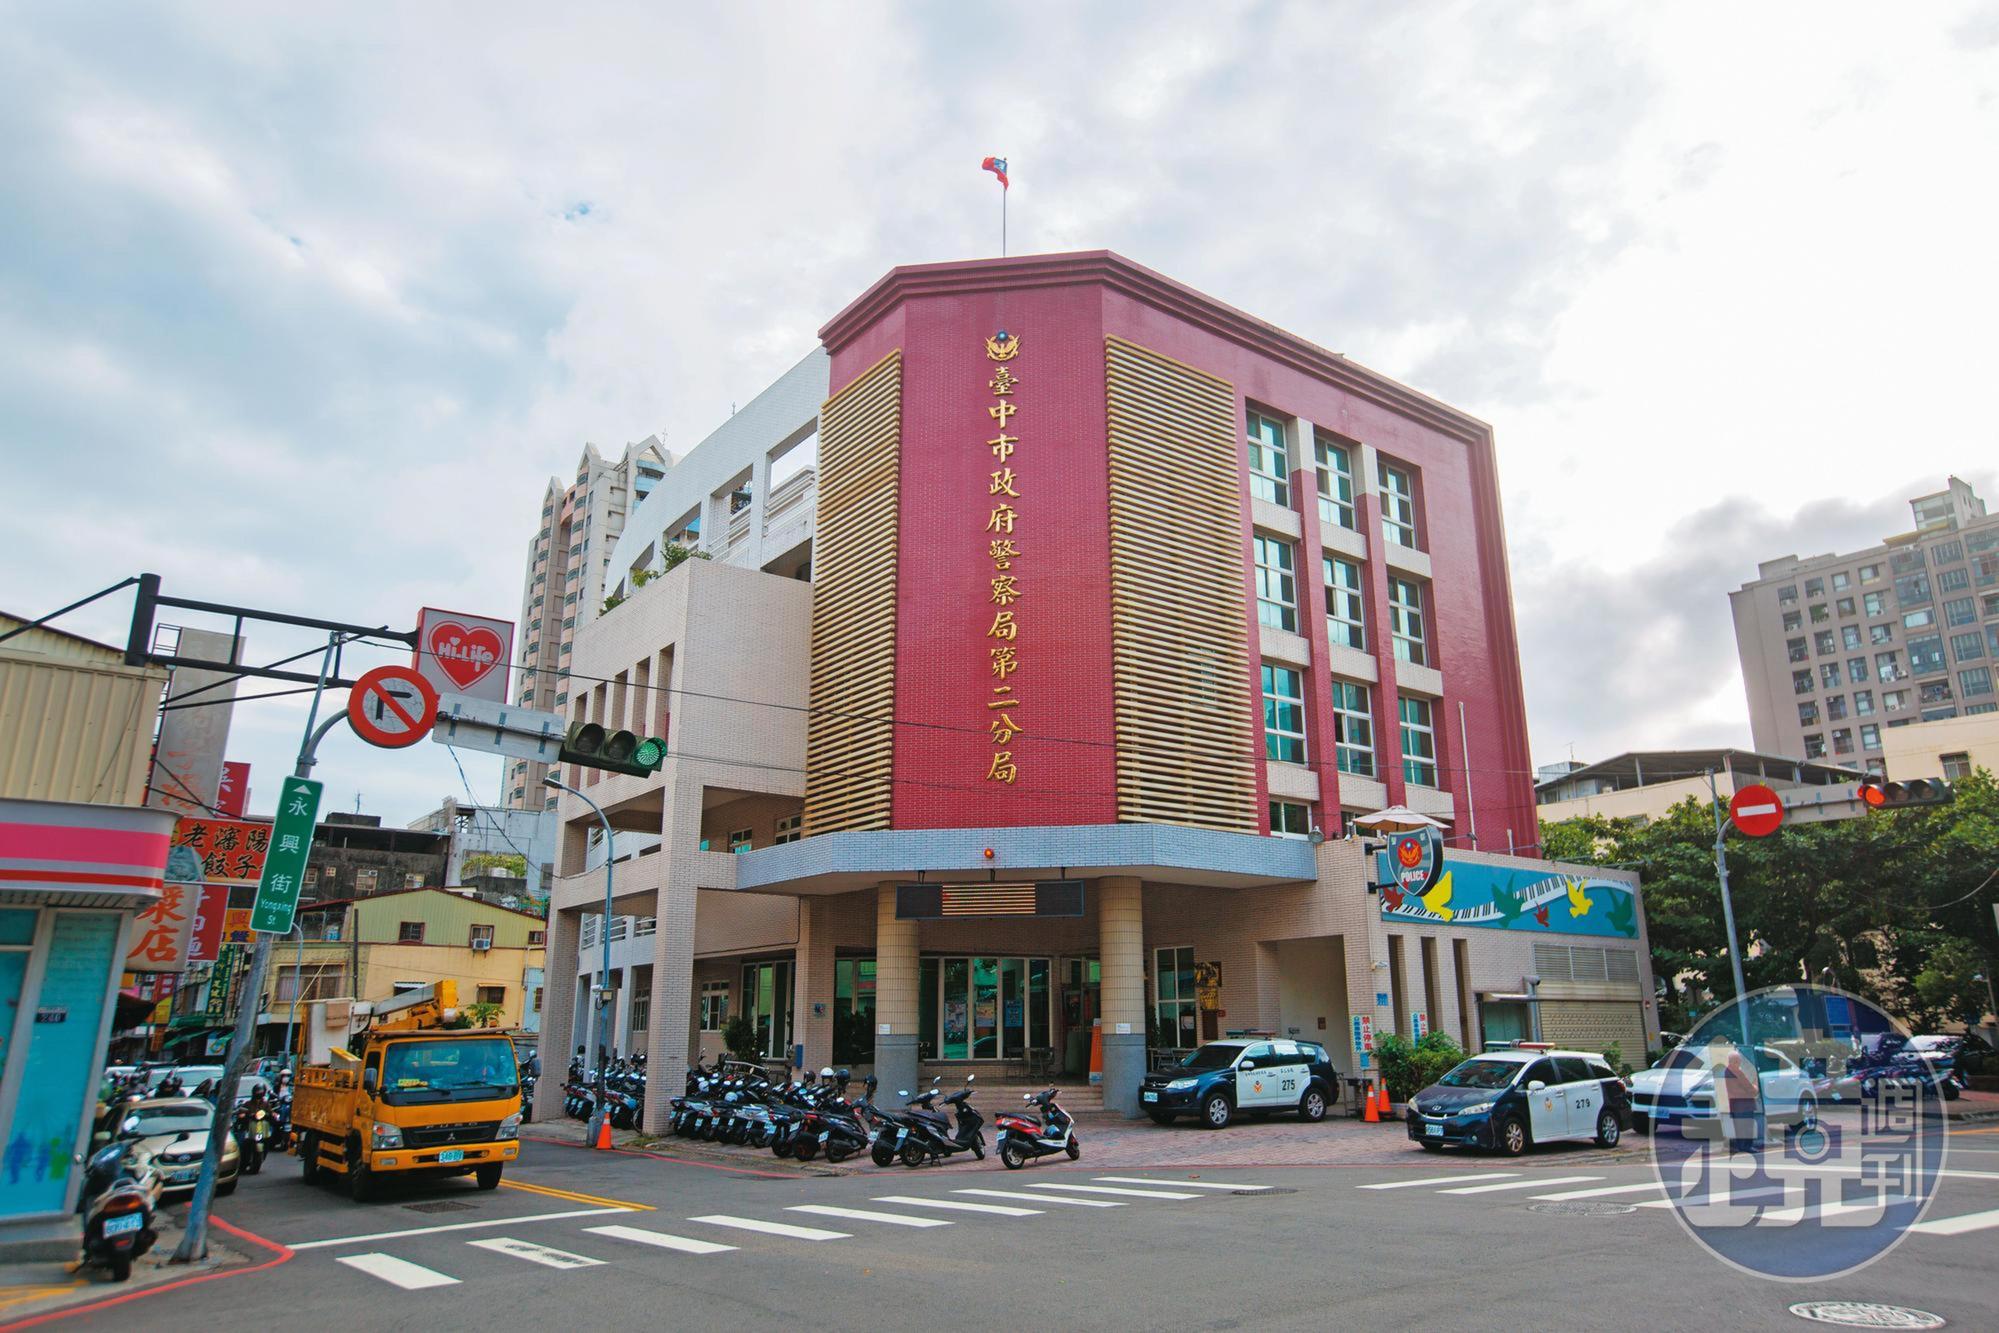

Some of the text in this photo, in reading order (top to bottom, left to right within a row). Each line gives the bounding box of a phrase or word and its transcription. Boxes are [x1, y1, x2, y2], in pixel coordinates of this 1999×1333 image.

[985, 366, 1024, 784] 臺中市政府警察局第二分局
[271, 797, 308, 894] 永興街
[1400, 870, 1425, 883] POLICE
[1282, 1080, 1296, 1091] 275
[1576, 1098, 1591, 1109] 279
